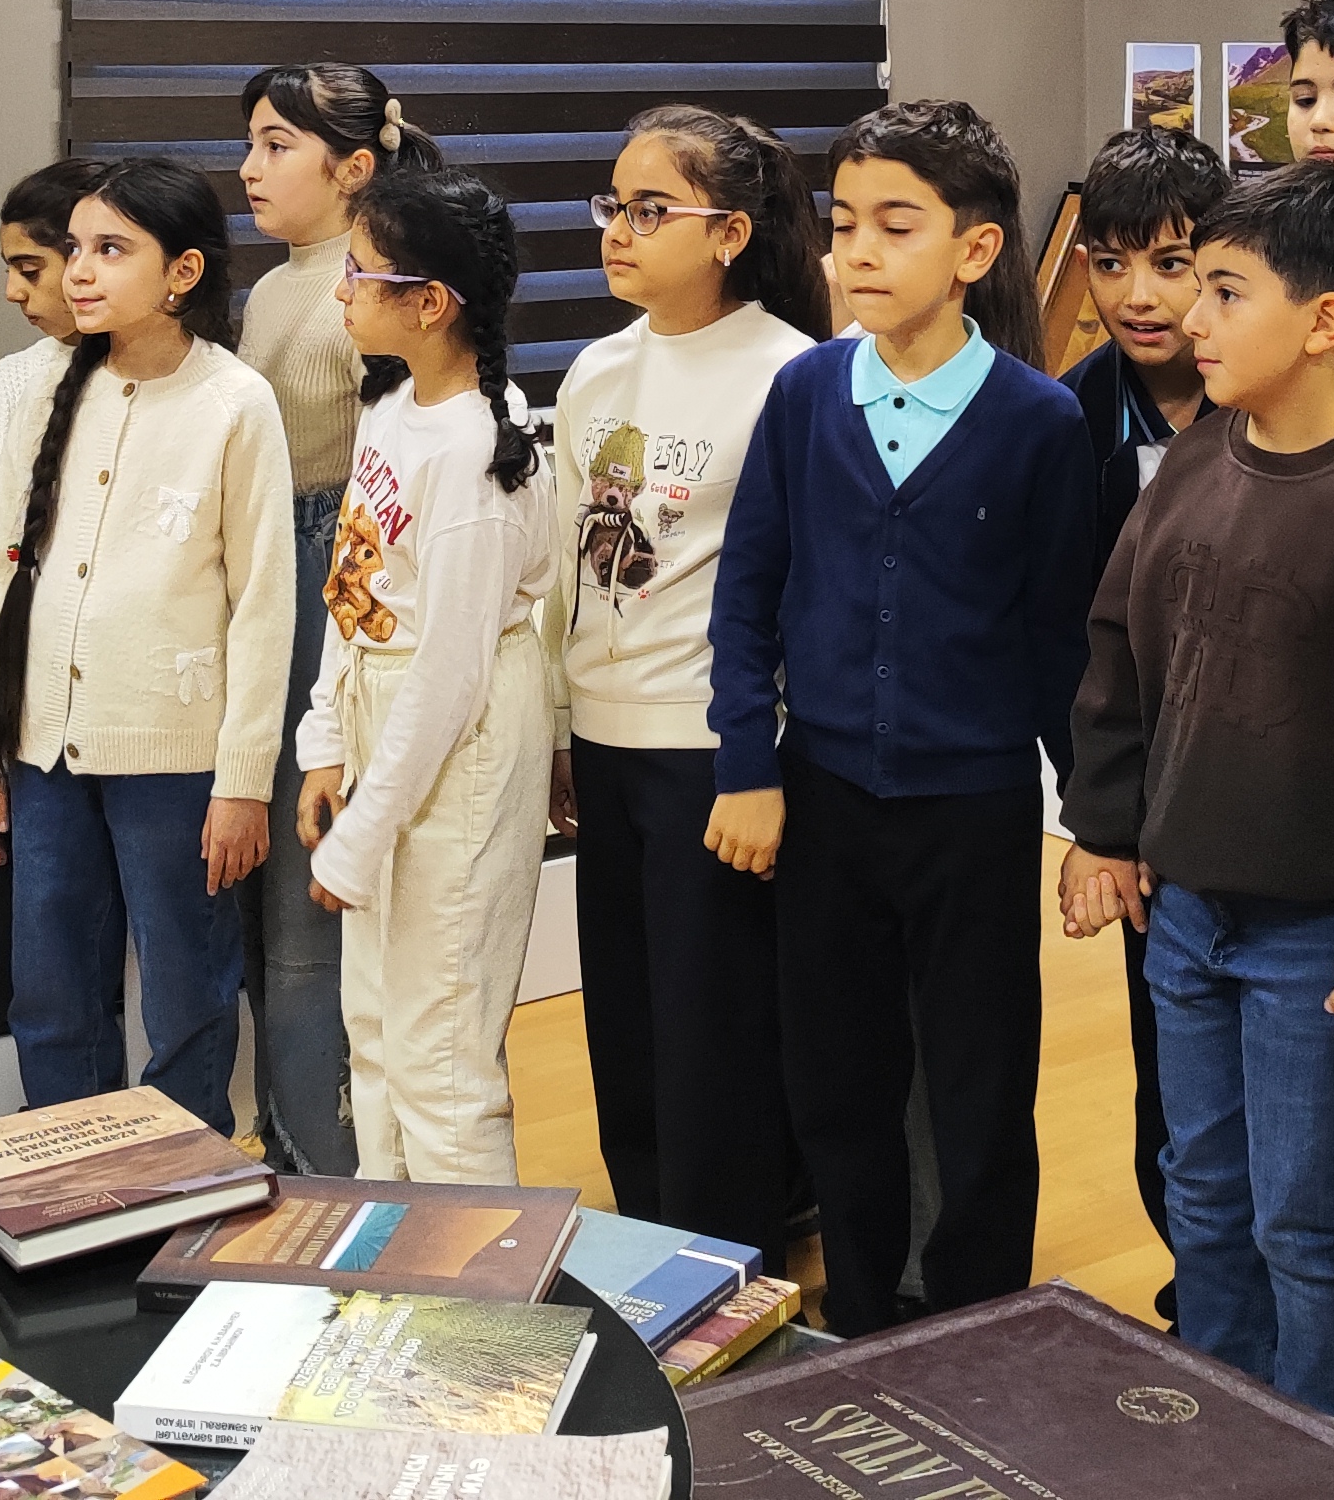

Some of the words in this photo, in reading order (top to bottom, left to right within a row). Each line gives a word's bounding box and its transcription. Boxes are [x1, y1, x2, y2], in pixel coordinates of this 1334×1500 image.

[654, 435, 713, 482] TOY
[99, 1111, 161, 1134] TORPAQ
[333, 1397, 357, 1416] VƏ
[742, 1425, 864, 1500] RESPUBLİKASI
[783, 1402, 964, 1485] ATLAS
